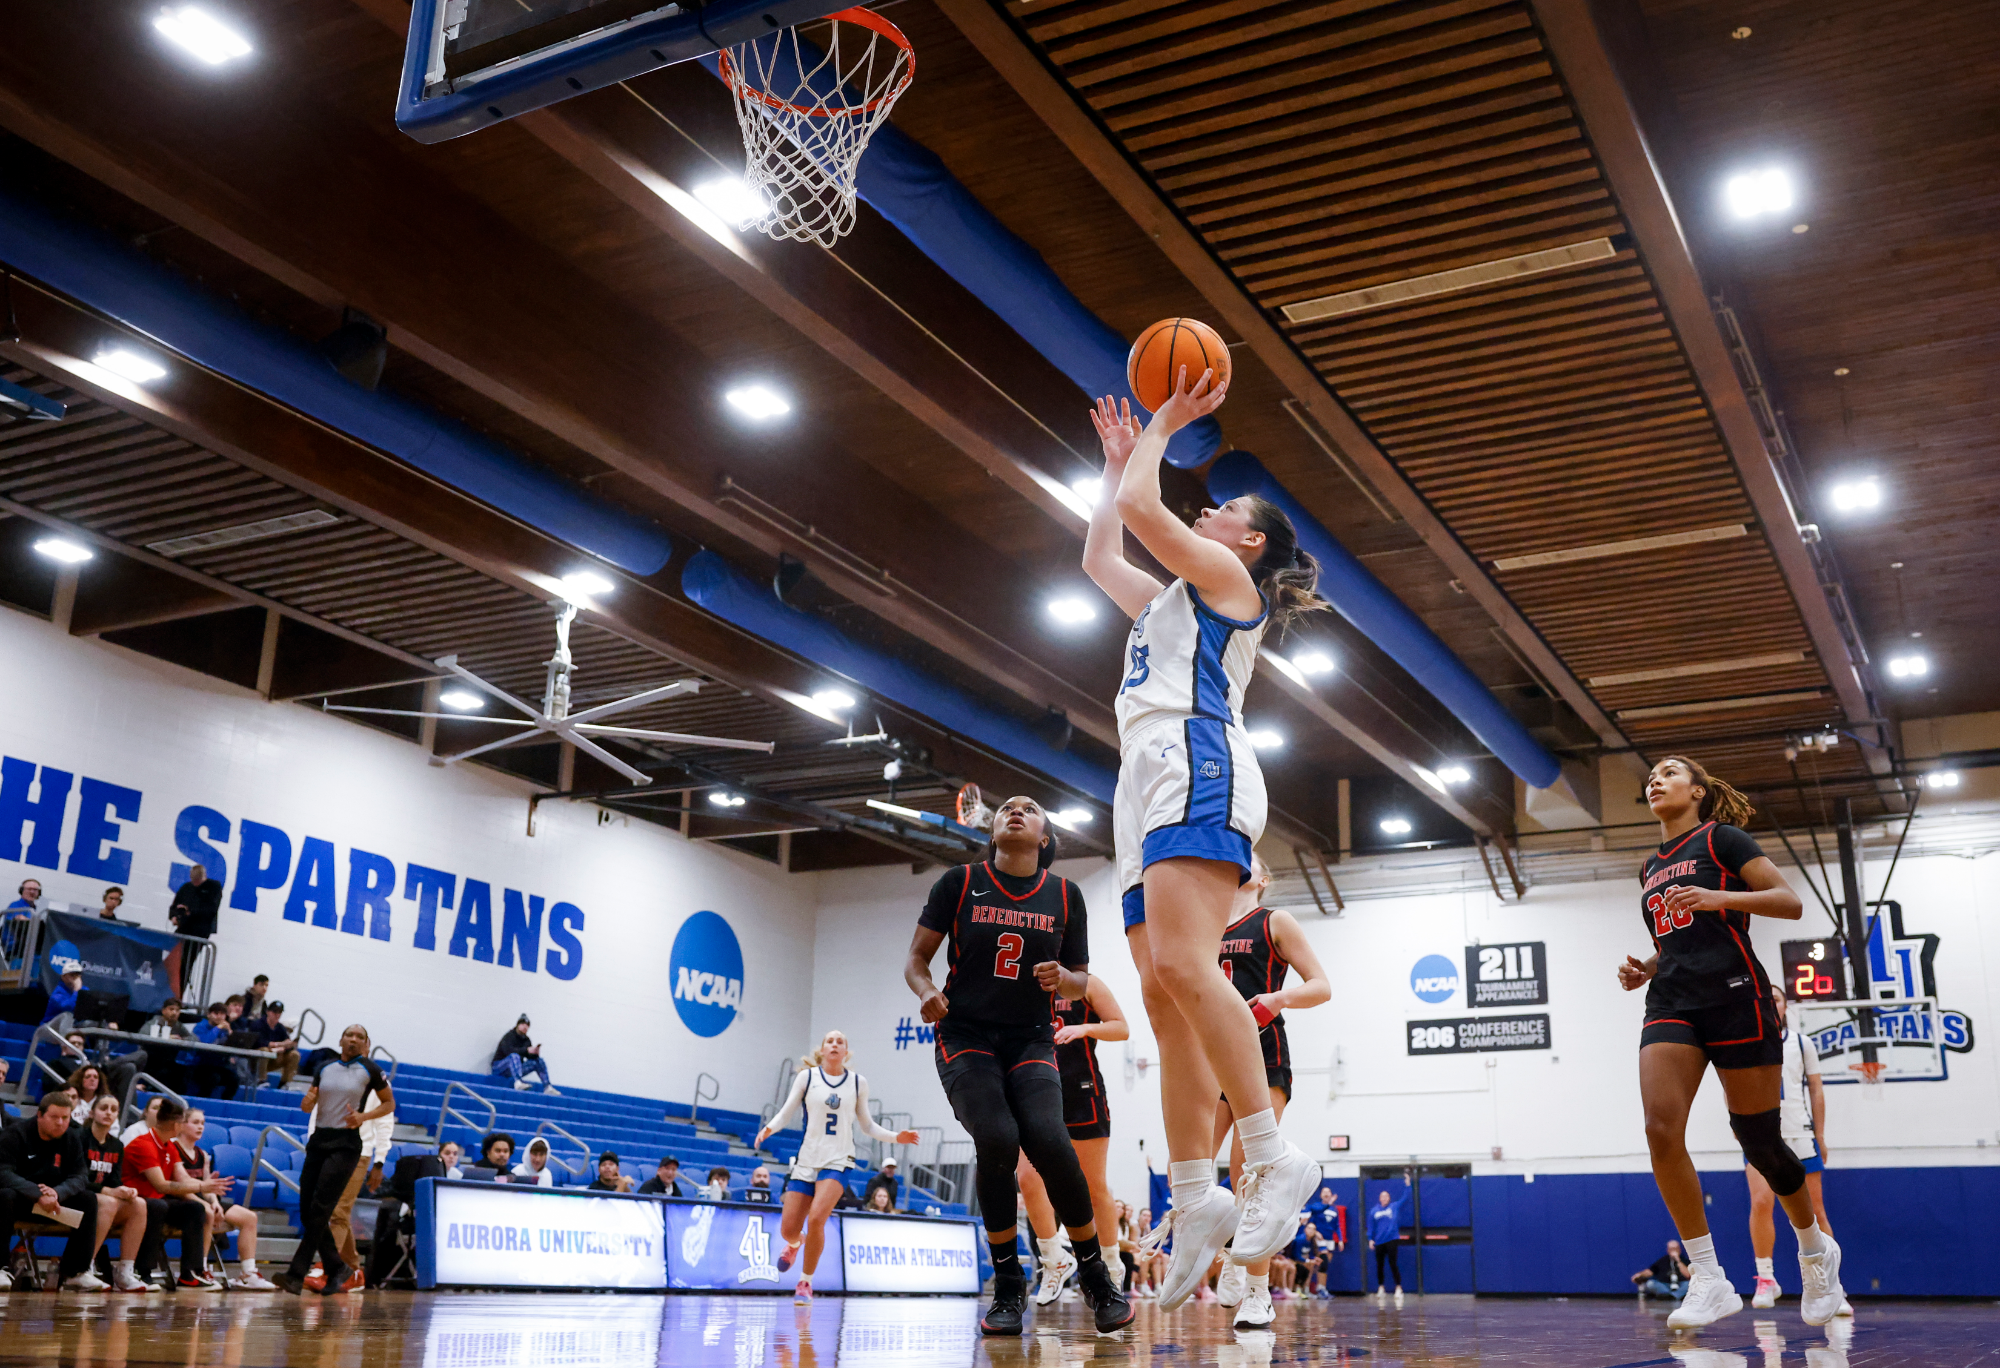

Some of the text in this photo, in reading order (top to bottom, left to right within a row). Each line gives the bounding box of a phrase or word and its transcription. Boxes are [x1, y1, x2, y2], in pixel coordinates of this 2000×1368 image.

[0, 755, 585, 981] HE SPARTANS
[972, 905, 1055, 933] BENEDICTINE
[994, 932, 1024, 980] 2
[1479, 946, 1534, 981] 211
[674, 967, 741, 1011] NCAA
[1414, 976, 1459, 993] NCAA
[1475, 980, 1539, 991] TOURNAMENT
[1476, 989, 1539, 1002] APPEARANCES
[1411, 1026, 1455, 1049] 206
[1458, 1020, 1545, 1037] CONFERENCE
[1460, 1033, 1545, 1048] CHAMPIONSHIPS
[825, 1113, 838, 1135] 2
[447, 1223, 654, 1257] AURORA UNIVERSITY
[849, 1244, 973, 1268] SPARTAN ATHLETICS
